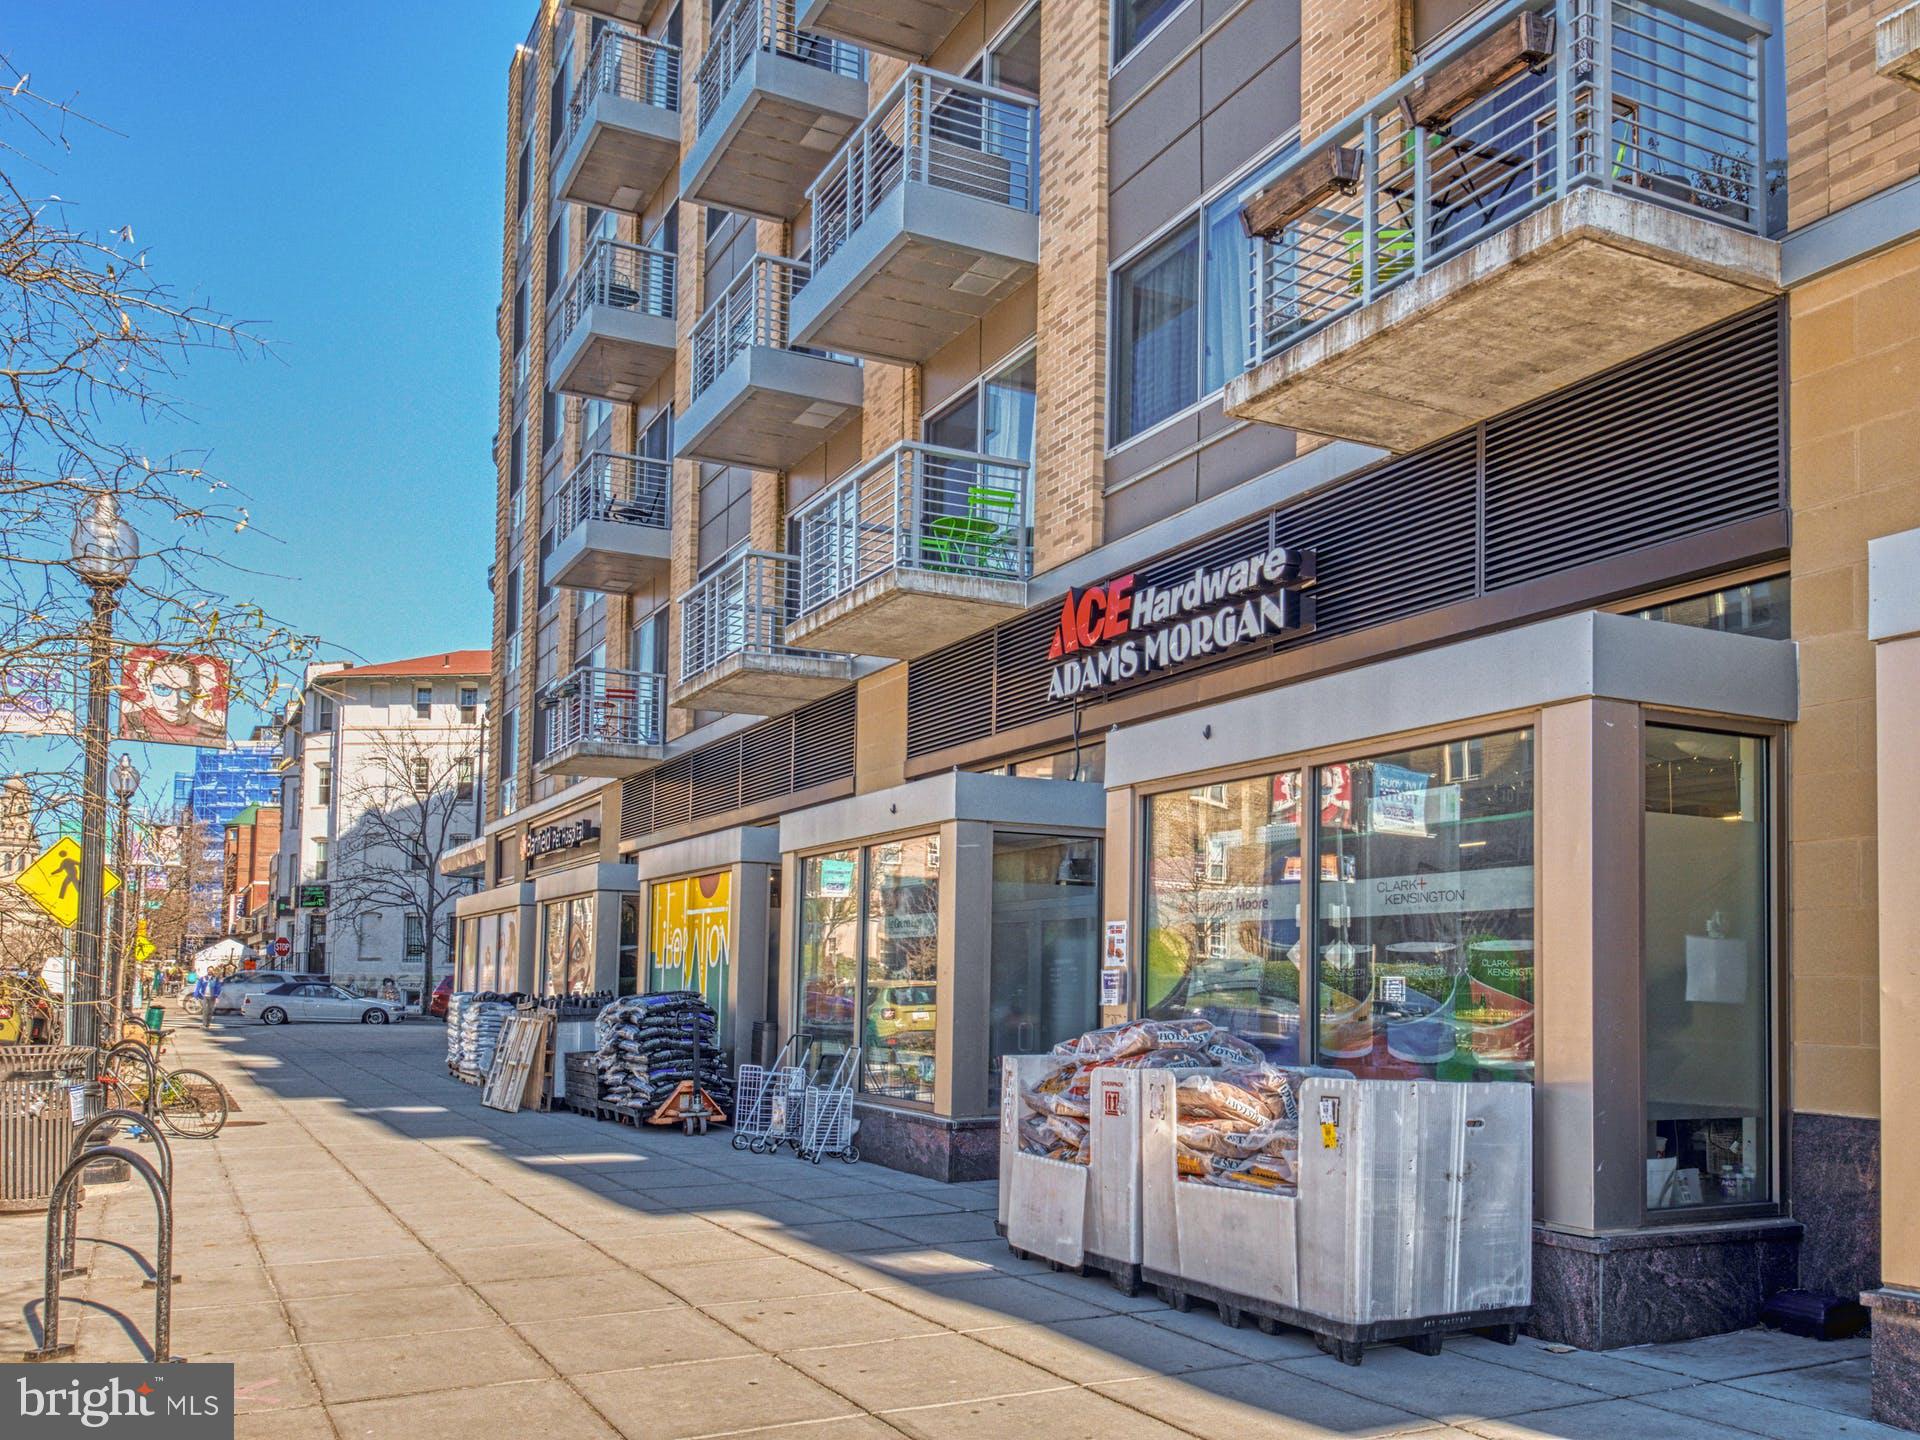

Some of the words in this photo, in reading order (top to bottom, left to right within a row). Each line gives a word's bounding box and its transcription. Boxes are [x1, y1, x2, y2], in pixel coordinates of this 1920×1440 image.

[1047, 574, 1136, 660] ACE
[1131, 547, 1287, 630] Hardware
[1048, 640, 1138, 701] ADAMS
[1145, 589, 1285, 671] MORGAN
[1236, 897, 1269, 910] Moore
[1384, 889, 1465, 905] KENSINGTON
[275, 943, 290, 951] STOP
[1481, 958, 1510, 967] CLARK
